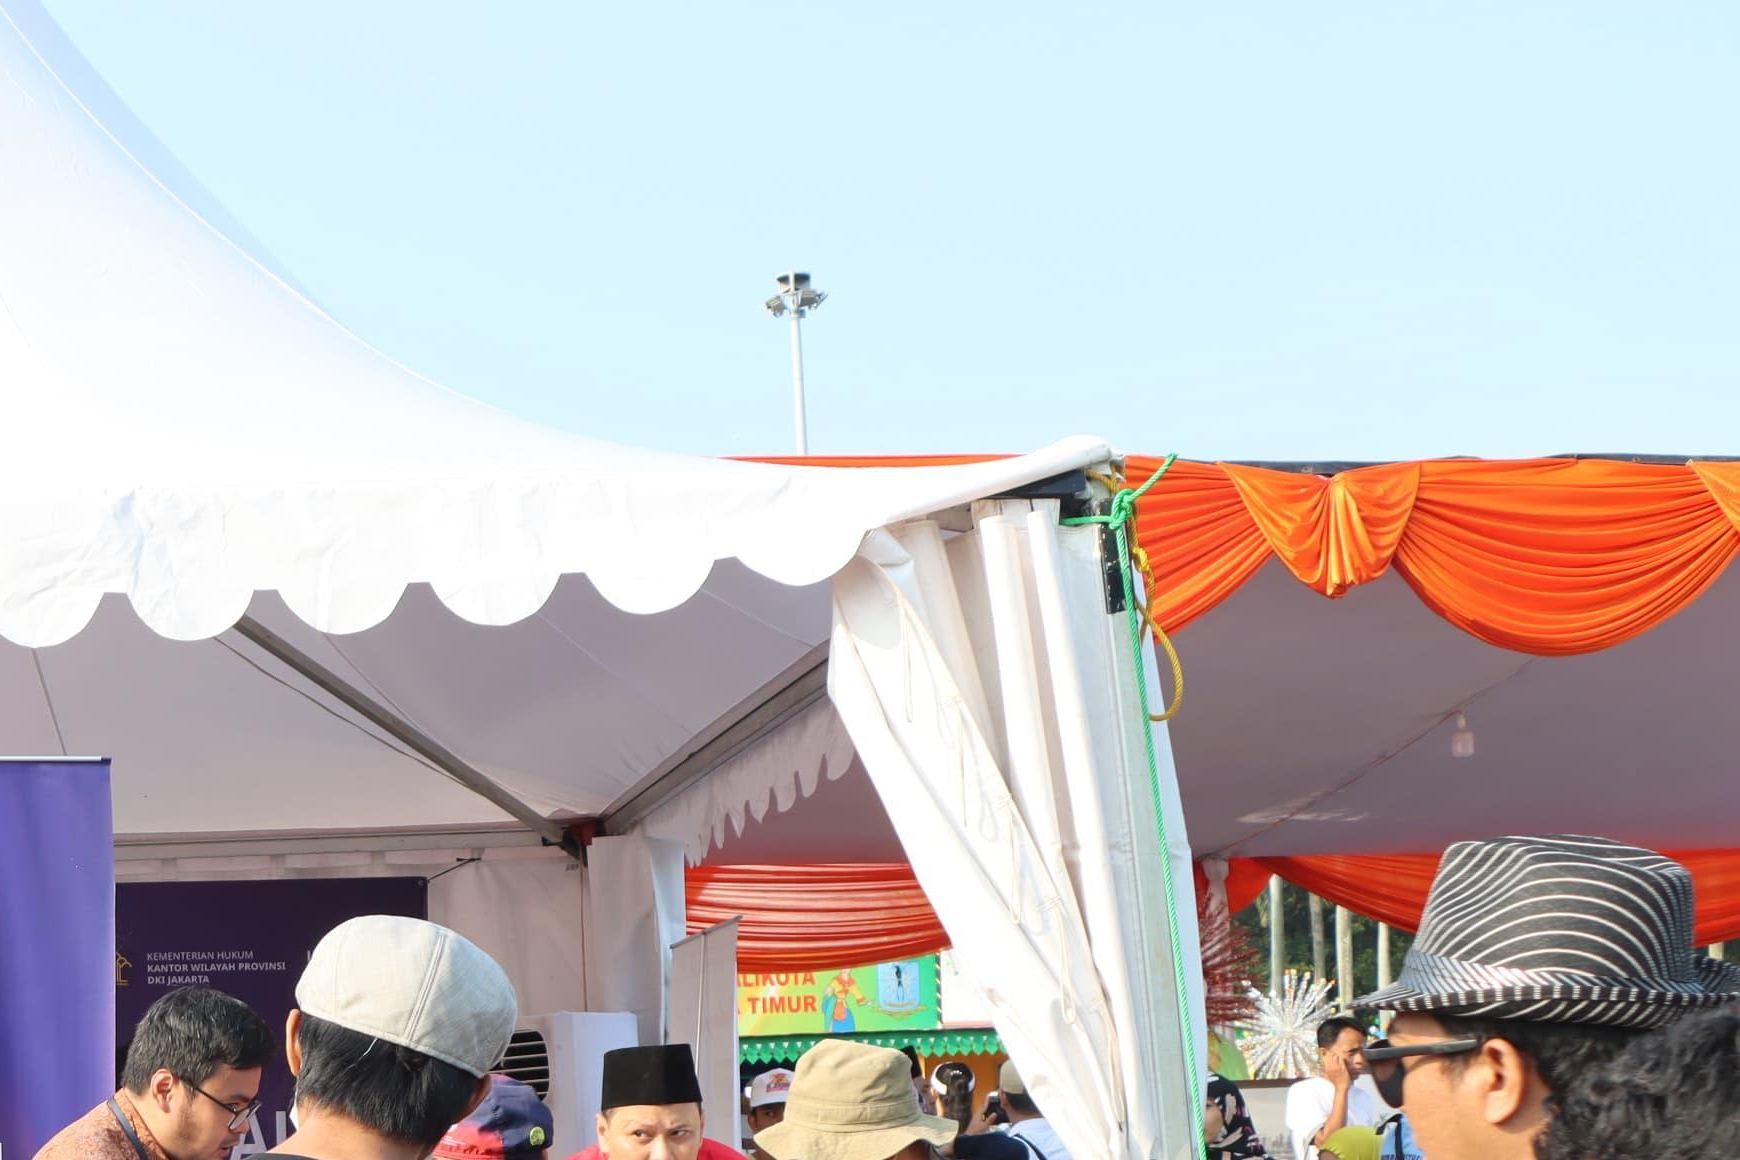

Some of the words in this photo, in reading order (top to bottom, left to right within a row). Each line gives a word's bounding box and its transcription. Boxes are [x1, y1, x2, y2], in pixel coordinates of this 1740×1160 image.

[147, 951, 215, 961] KEMENTERIAN
[217, 950, 254, 960] HUKUM
[147, 964, 189, 973] KANTOR
[190, 963, 236, 972] WILAYAH
[238, 962, 286, 971] PROVINSI
[147, 975, 166, 985] DKI
[166, 974, 210, 986] JAKARTA
[737, 971, 816, 987] LIKOTA
[747, 995, 817, 1015] TIMUR
